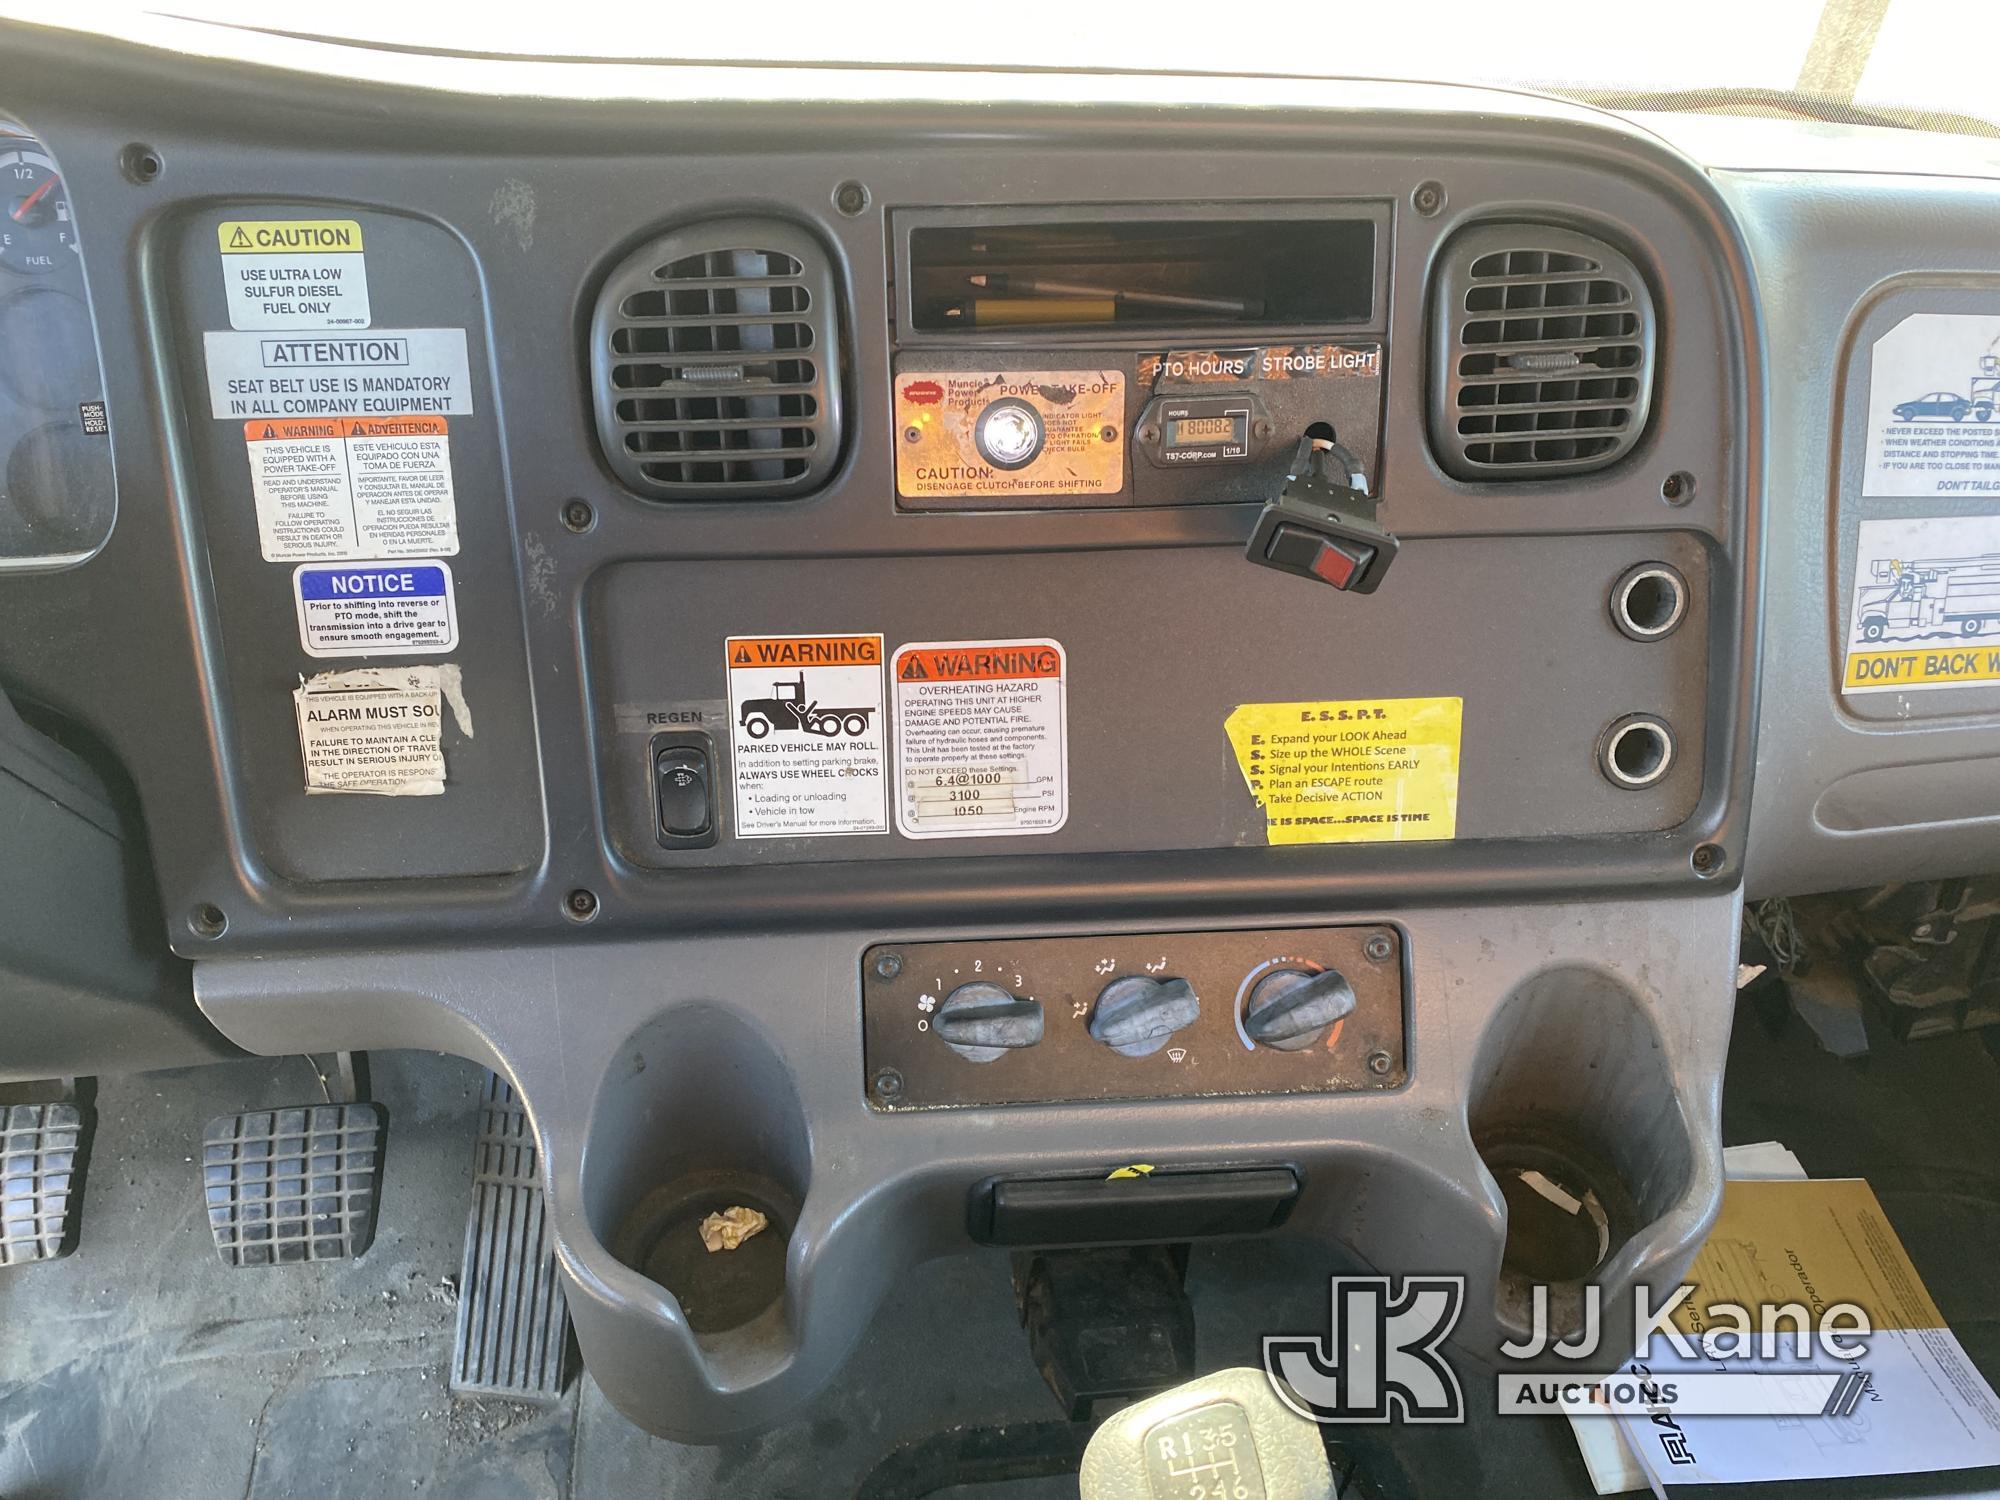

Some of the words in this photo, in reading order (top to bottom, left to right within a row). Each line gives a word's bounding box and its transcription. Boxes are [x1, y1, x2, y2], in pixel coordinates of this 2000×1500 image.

[14, 168, 33, 179] 1/2
[3, 234, 12, 245] E
[59, 233, 67, 243] F
[256, 229, 350, 247] CAUTION
[25, 256, 53, 265] FUEL
[241, 270, 267, 281] USE
[270, 269, 310, 281] ULTRA
[313, 269, 342, 280] LOW
[244, 286, 296, 298] SULFUR
[298, 285, 343, 297] DIESEL
[263, 303, 296, 315] FUEL
[298, 302, 331, 314] ONLY
[273, 342, 400, 363] ATTENTION
[1152, 363, 1184, 377] PTO
[1189, 360, 1244, 376] HOURS
[1262, 355, 1325, 372] STROBE
[1330, 353, 1376, 370] LIGHT
[228, 380, 264, 394] SEAT
[270, 379, 304, 393] BELT
[310, 378, 339, 392] USE
[343, 378, 358, 392] IS
[363, 376, 451, 391] MANDATORY
[231, 400, 246, 414] IN
[252, 400, 282, 414] ALL
[283, 398, 357, 413] COMPANY
[363, 397, 452, 412] EQUIPMENT
[283, 426, 334, 437] WARNING
[368, 423, 439, 434] ADVERTENCIA
[916, 468, 994, 480] CAUTION:
[917, 482, 975, 491] DISENGAGE
[977, 481, 1015, 490] CLUTCH
[1018, 480, 1055, 489] BEFORE
[1058, 480, 1102, 488] SHIFTING
[1937, 480, 1970, 491] DON'T
[331, 573, 415, 594] NOTICE
[310, 603, 331, 611] Prior
[333, 602, 342, 610] to
[344, 601, 376, 610] shifting
[335, 612, 352, 620] PTO
[355, 611, 382, 620] mode,
[383, 610, 402, 618] shift
[404, 610, 418, 618] the
[310, 623, 364, 631] transmission
[367, 622, 383, 630] into
[393, 621, 414, 629] drive
[416, 621, 435, 630] gear
[437, 620, 446, 628] to
[351, 633, 383, 641] smooth
[385, 631, 440, 641] engagement.
[757, 642, 876, 663] WARNING
[934, 651, 1056, 676] WARNING
[1856, 656, 1918, 680] DON'T
[1924, 653, 1979, 676] BACK
[919, 686, 993, 696] OVERHEATING
[996, 683, 1038, 693] HAZARD
[307, 708, 361, 722] ALARM
[366, 706, 408, 719] MUST
[647, 712, 702, 724] REGEN
[1301, 711, 1315, 722] E.
[1320, 711, 1334, 721] S.
[1338, 710, 1353, 720] S.
[1357, 709, 1371, 719] P.
[1373, 708, 1386, 719] T.
[1251, 735, 1265, 745] E.
[1271, 734, 1309, 745] Expand
[1312, 734, 1337, 744] your
[1340, 731, 1369, 742] LOOK
[1372, 730, 1406, 741] Ahead
[738, 744, 779, 753] PARKED
[780, 743, 823, 753] VEHICLE
[826, 742, 847, 751] MAY
[849, 741, 879, 750] ROLL.
[1251, 750, 1265, 760] S.
[1270, 749, 1291, 759] Size
[1294, 750, 1308, 761] up
[1311, 748, 1328, 757] the
[1331, 746, 1371, 756] WHOLE
[1374, 745, 1406, 755] Scene
[358, 756, 396, 765] SERIOUS
[399, 754, 431, 762] INJURY
[1270, 762, 1301, 775] Signal
[1304, 764, 1327, 774] your
[1331, 761, 1385, 772] Intentions
[1388, 760, 1420, 770] EARLY
[739, 770, 778, 780] ALWAYS
[780, 770, 800, 778] USE
[801, 769, 836, 778] WHEEL
[936, 773, 1001, 787] 6.4@1000
[739, 782, 764, 791] when:
[1270, 778, 1292, 789] Plan
[1294, 780, 1308, 788] an
[1311, 777, 1351, 787] ESCAPE
[1354, 776, 1383, 786] route
[755, 794, 790, 803] Loading
[804, 792, 847, 802] unloading
[949, 789, 980, 801] 3100
[1269, 793, 1292, 803] Take
[1295, 793, 1339, 803] Decisive
[1341, 791, 1383, 801] ACTION
[755, 807, 786, 816] Vehicle
[799, 807, 815, 815] tow
[954, 805, 983, 816] 1050
[1038, 804, 1055, 812] RPM
[1387, 814, 1399, 822] IS
[1401, 813, 1430, 823] TIME
[974, 959, 983, 973] 2
[934, 978, 942, 991] 1
[1014, 974, 1023, 988] 3
[1784, 1248, 1827, 1317] Operador
[1158, 1436, 1178, 1460] R
